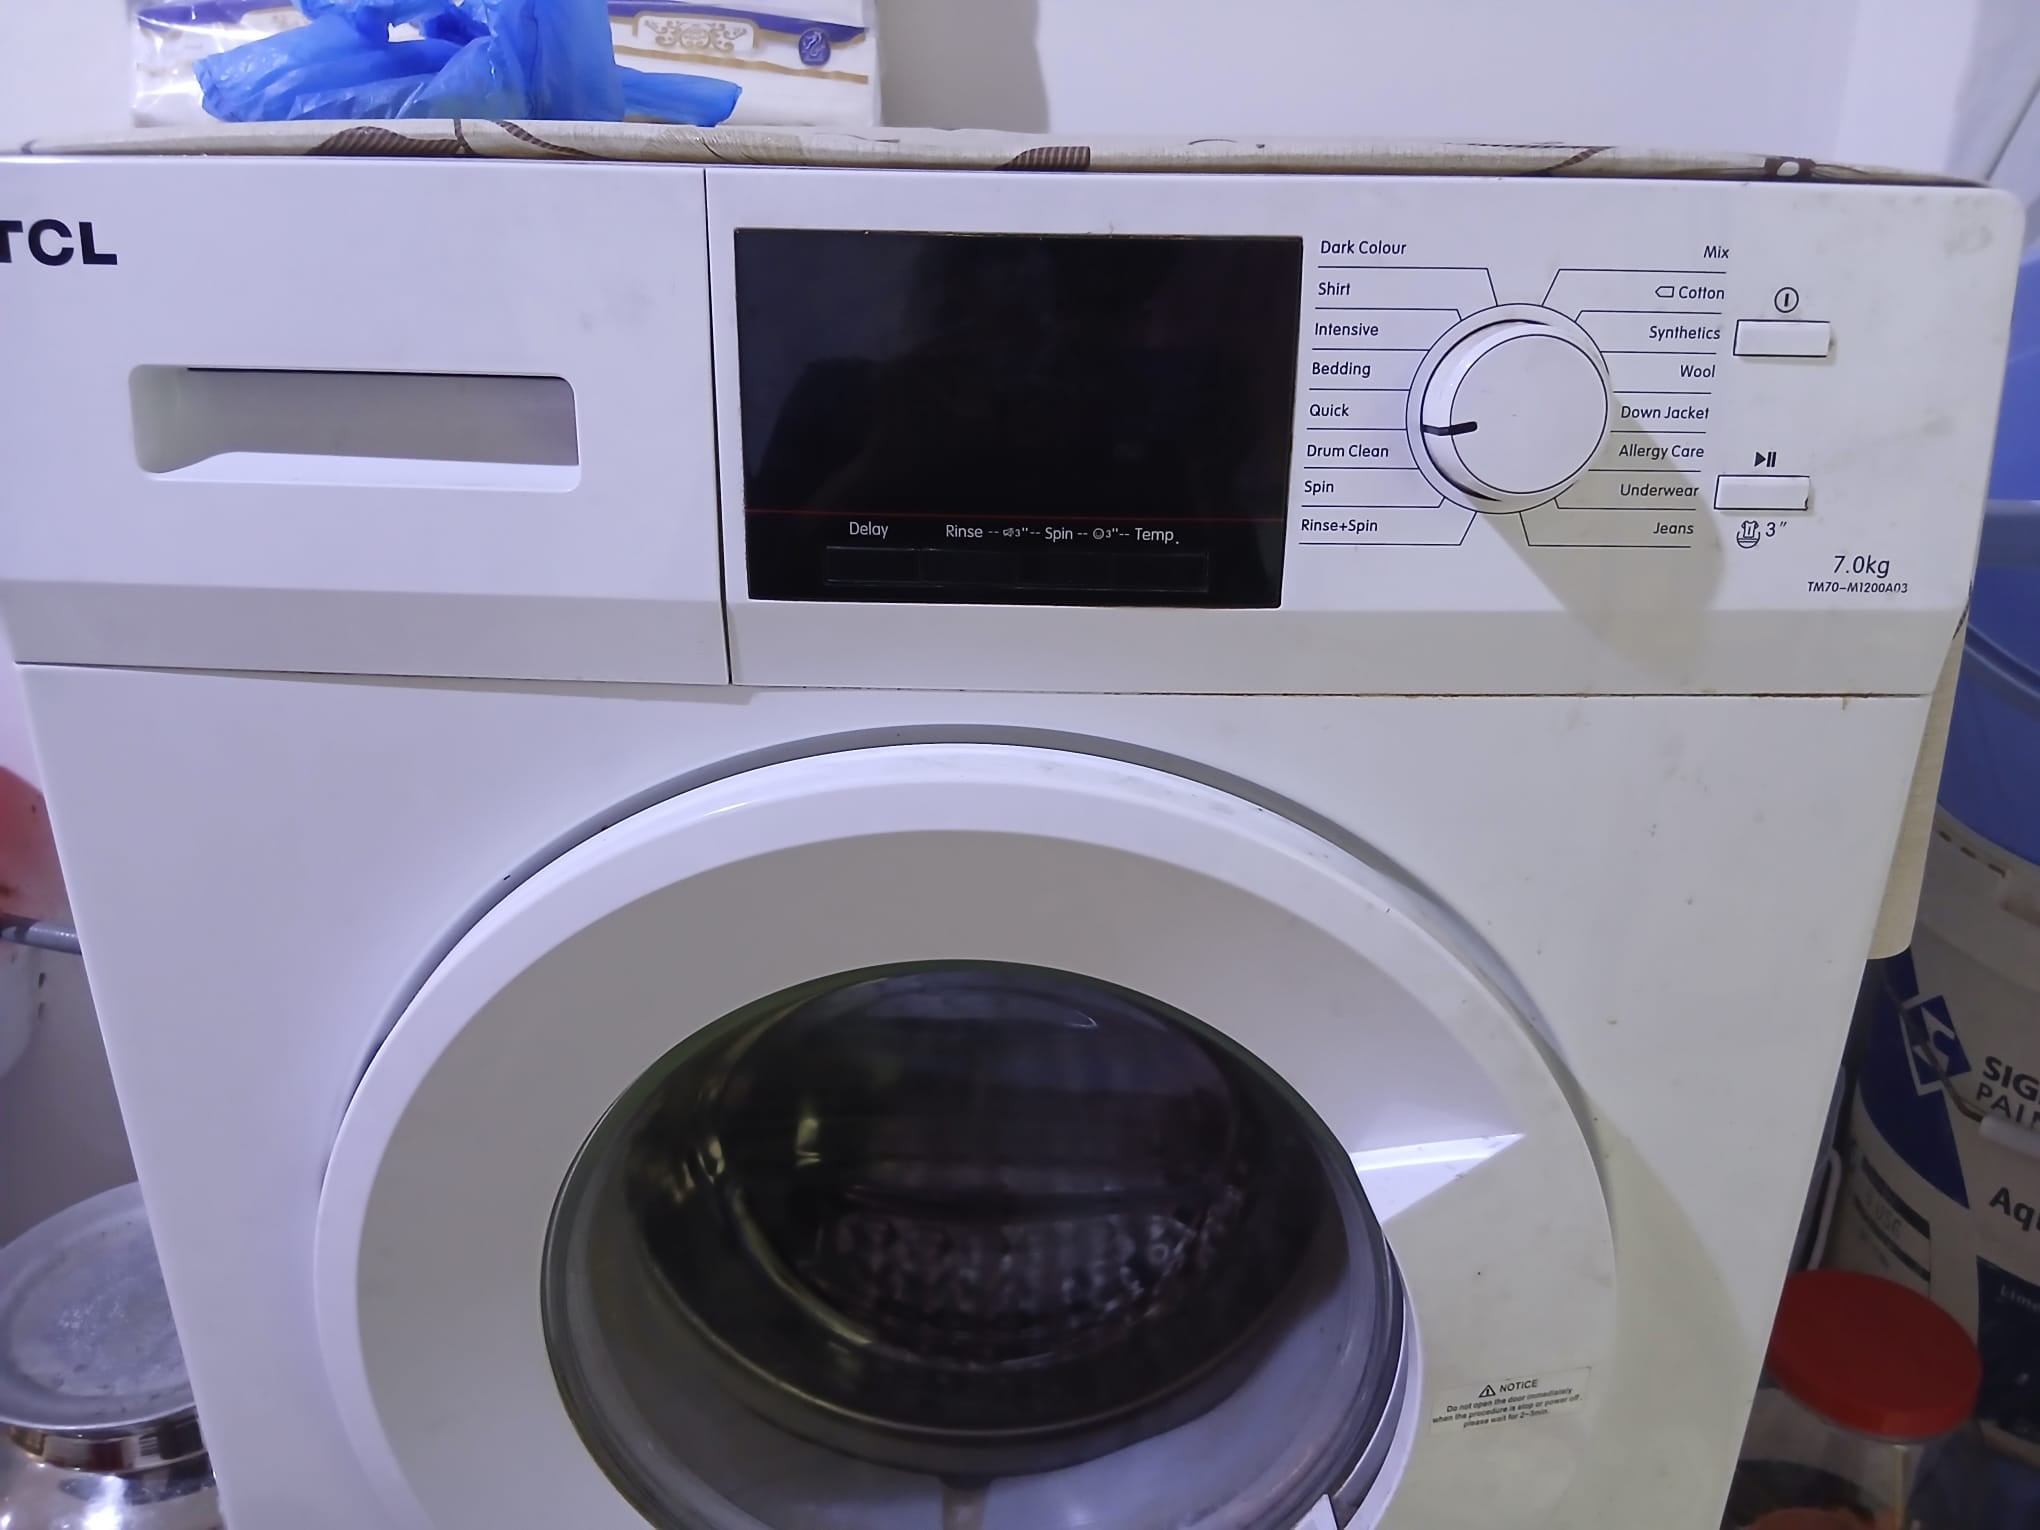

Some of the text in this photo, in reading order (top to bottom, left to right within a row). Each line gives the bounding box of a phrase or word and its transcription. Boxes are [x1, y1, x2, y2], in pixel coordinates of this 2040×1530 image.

[0, 218, 118, 267] TCL
[1320, 240, 1407, 255] Dark Colour
[1703, 245, 1729, 259] Mix
[1318, 281, 1351, 296] Shirt
[1678, 285, 1725, 300] Cotton
[1314, 322, 1379, 337] Intensive
[1648, 325, 1721, 342] Synthetics
[1312, 361, 1371, 379] Bedding
[1680, 364, 1716, 378] Wool
[1309, 403, 1349, 417] Quick
[1620, 405, 1709, 420] Down Jacket
[1307, 444, 1389, 458] Drum Clean
[1618, 443, 1705, 460] Allergy Care
[1304, 480, 1334, 496] Spin
[1620, 483, 1699, 497] Underwear
[849, 521, 889, 540] Delay
[945, 524, 984, 539] Rinse
[1044, 527, 1073, 543] Spin
[1301, 518, 1378, 535] Rinse+Spin
[1653, 522, 1694, 535] Jeans
[1833, 554, 1890, 579] 7.0kg
[1807, 581, 1908, 594] TM70-M1200A03
[1982, 1055, 2040, 1105] SIG
[1499, 1379, 1538, 1392] NOTICE
[1432, 1415, 1454, 1424] when
[1469, 1407, 1508, 1419] procedure
[1517, 1403, 1534, 1412] stop
[1544, 1398, 1569, 1408] power
[1446, 1405, 1458, 1413] Do
[1459, 1402, 1472, 1411] not
[1473, 1400, 1492, 1410] open
[1494, 1398, 1506, 1406] the
[1508, 1395, 1525, 1404] door
[1464, 1418, 1490, 1429] please
[1491, 1415, 1506, 1424] wait
[1508, 1413, 1518, 1421] for
